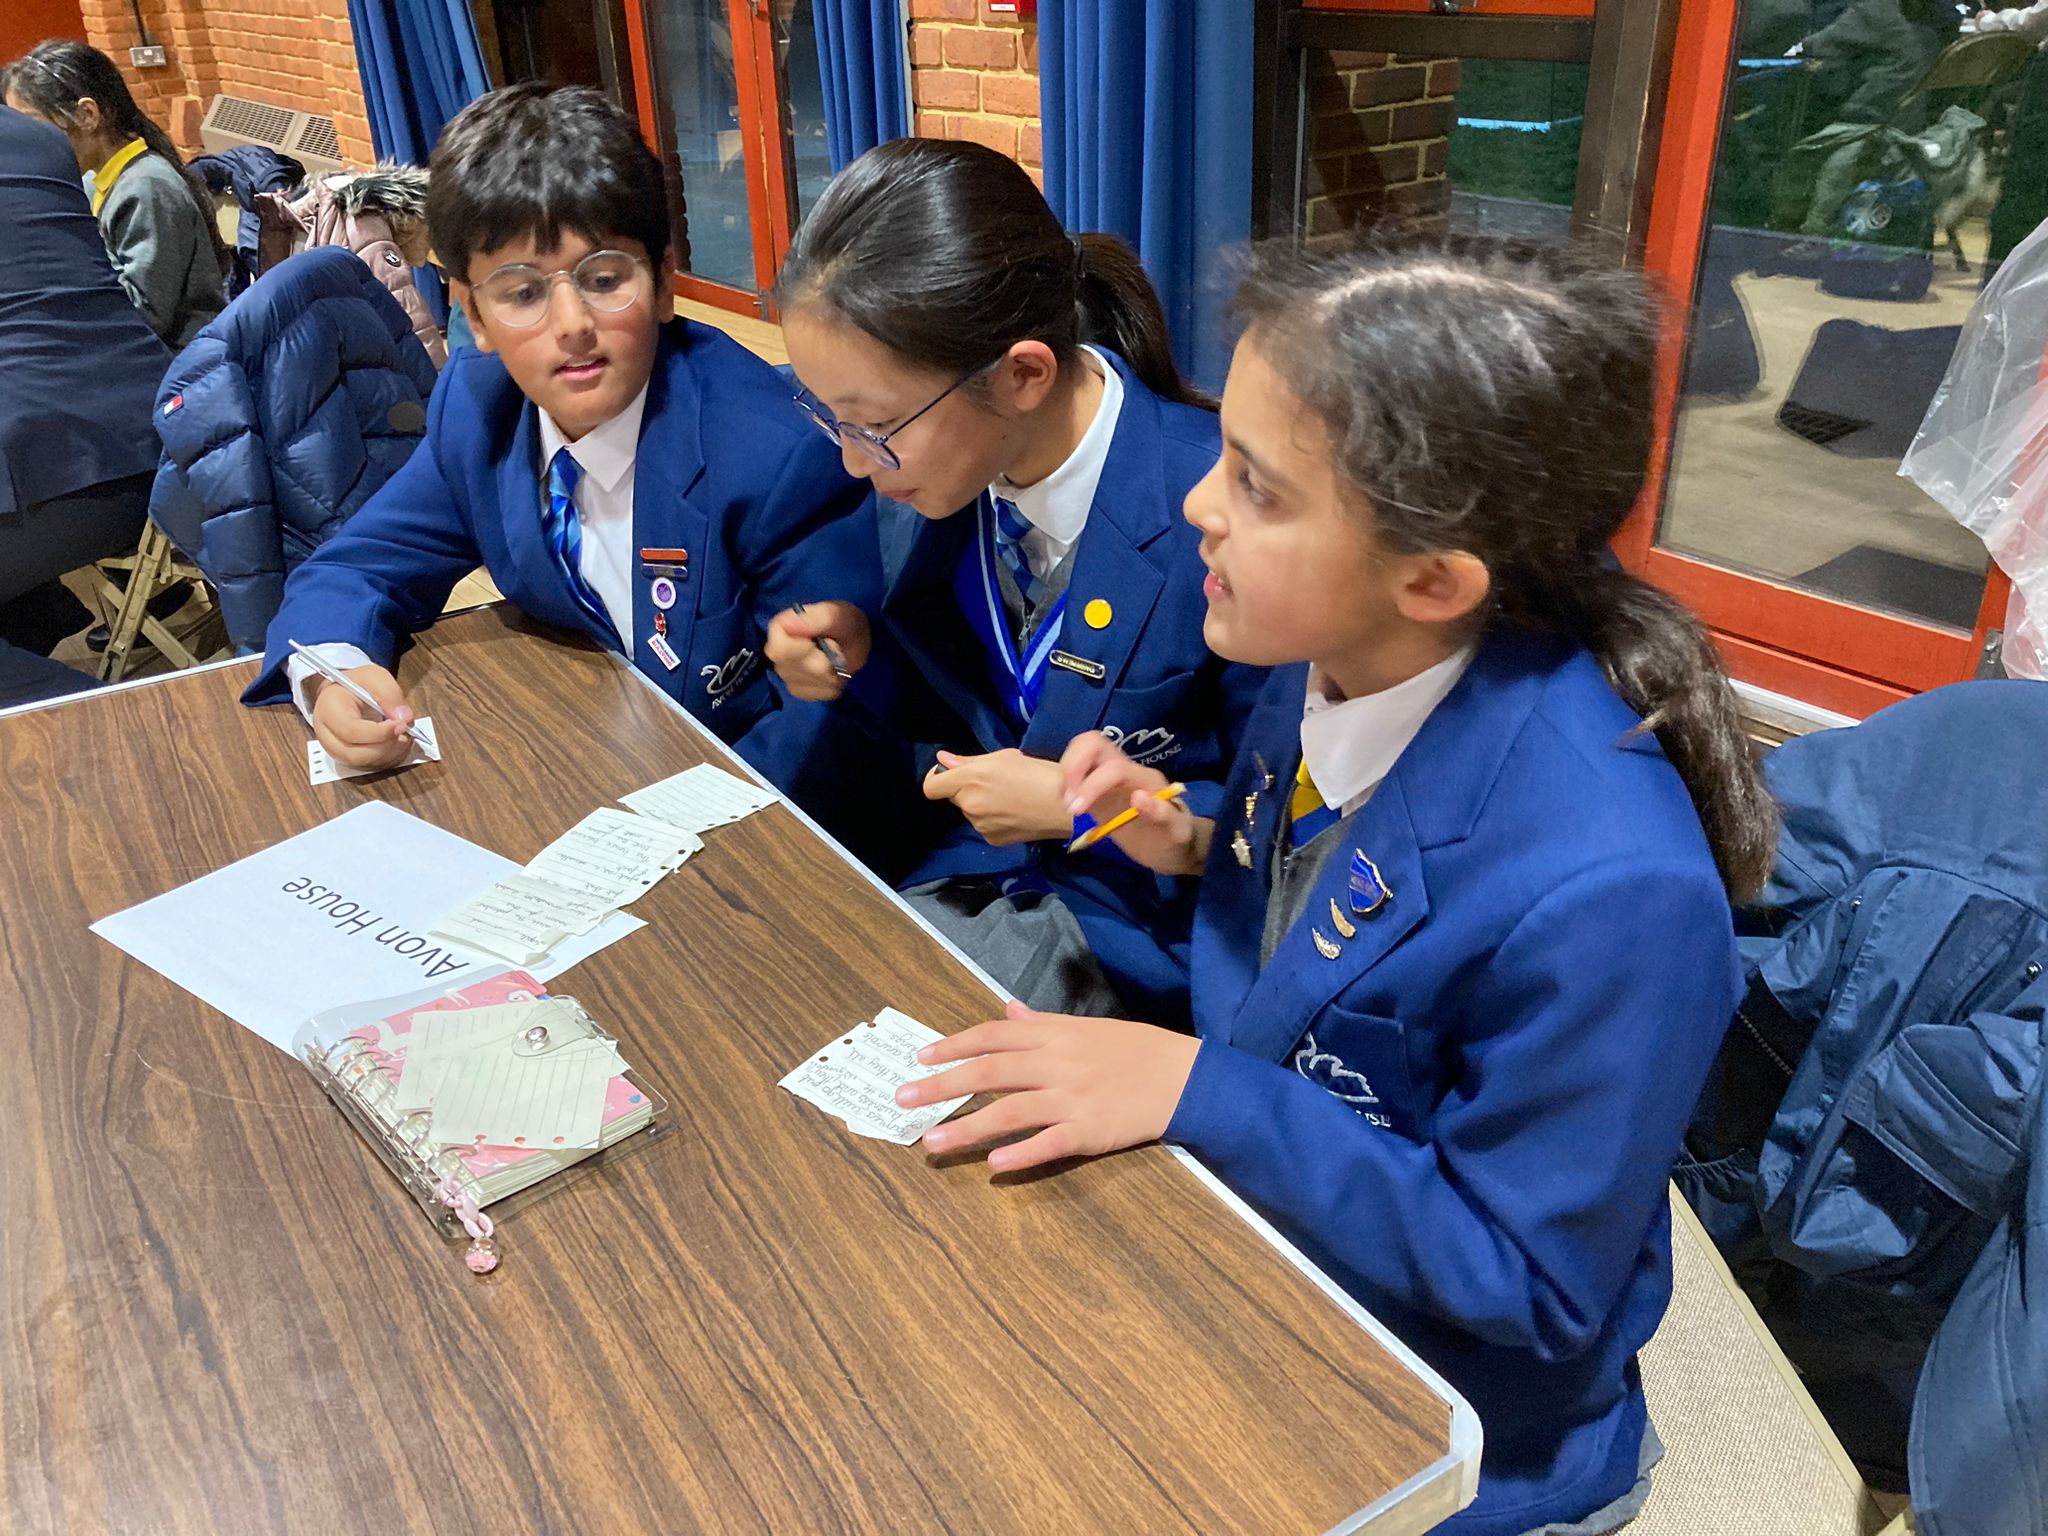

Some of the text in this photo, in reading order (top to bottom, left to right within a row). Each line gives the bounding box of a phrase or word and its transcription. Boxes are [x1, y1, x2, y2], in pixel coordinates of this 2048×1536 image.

[1140, 743, 1182, 766] HOUSE
[282, 877, 470, 978] Avon House
[848, 1047, 869, 1063] all
